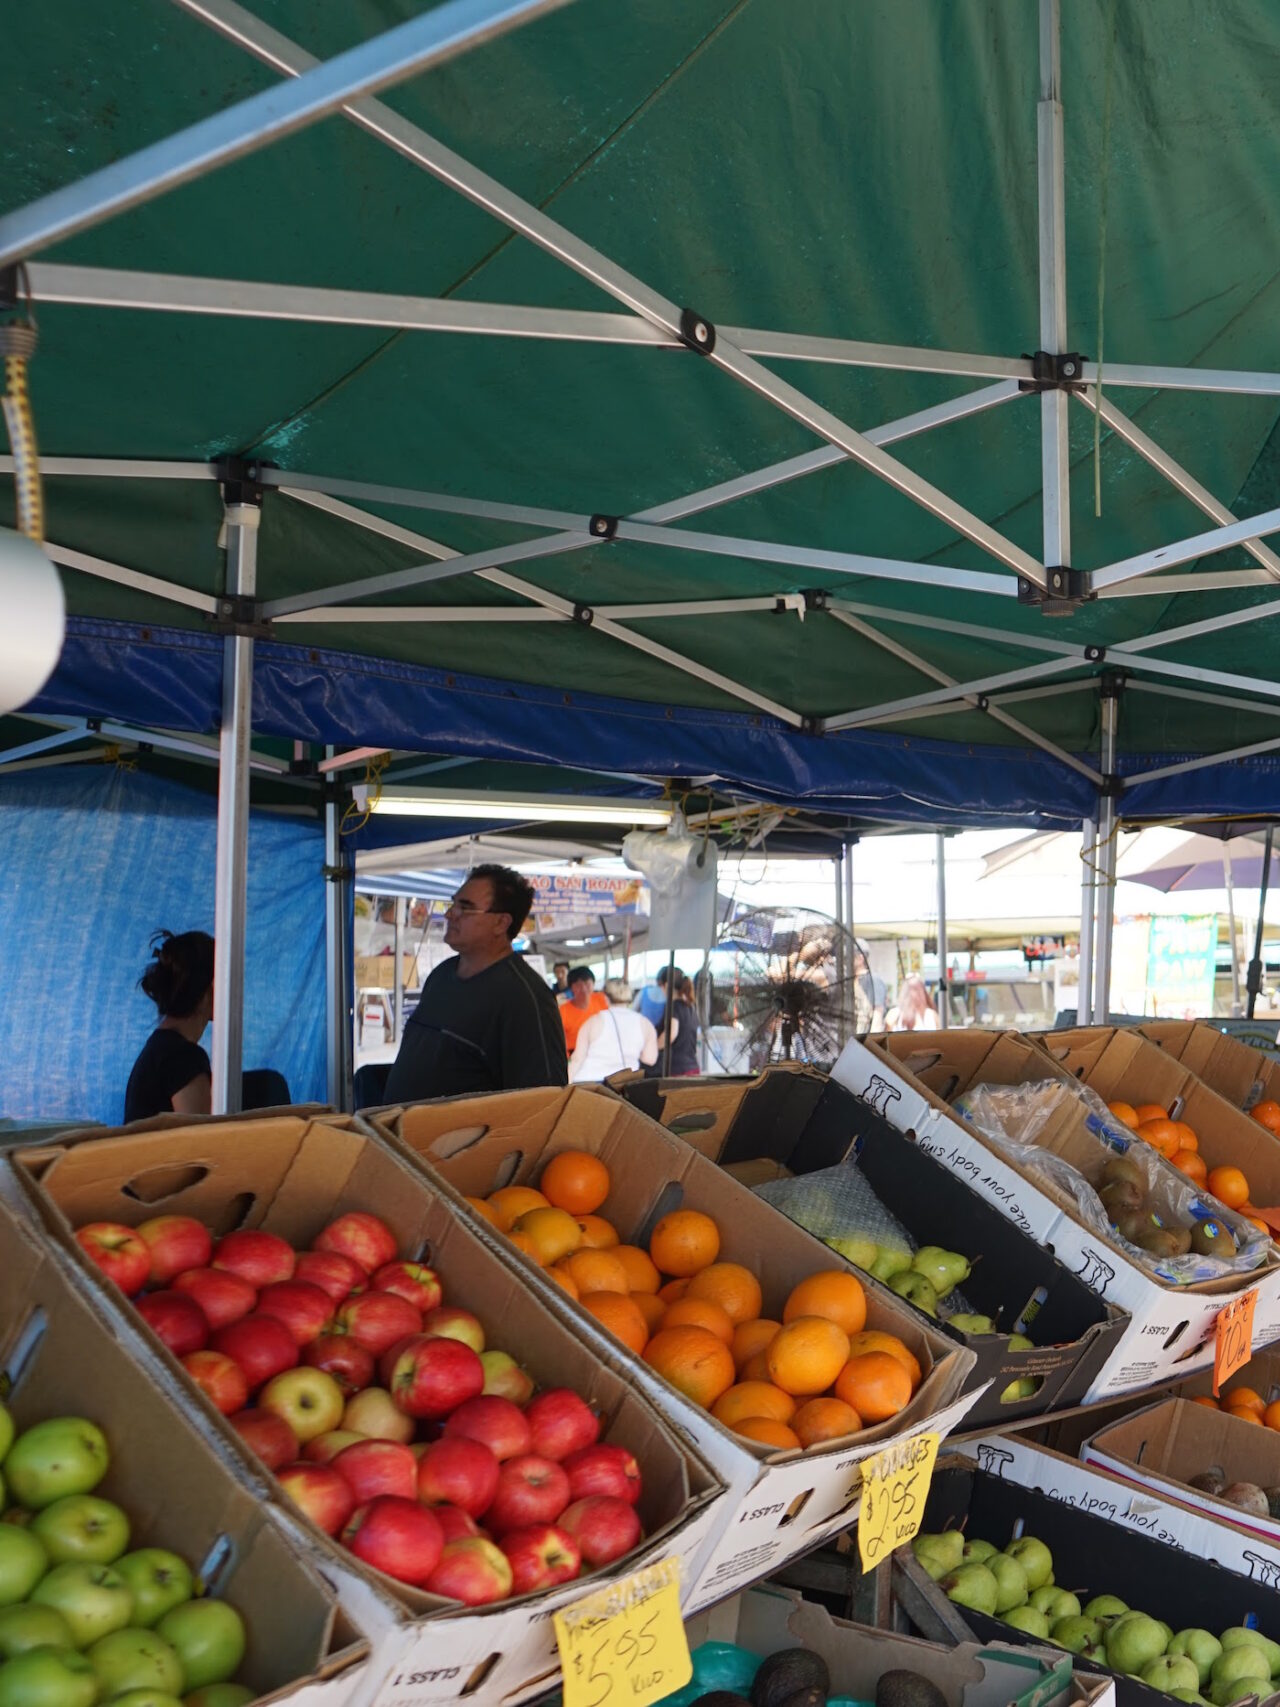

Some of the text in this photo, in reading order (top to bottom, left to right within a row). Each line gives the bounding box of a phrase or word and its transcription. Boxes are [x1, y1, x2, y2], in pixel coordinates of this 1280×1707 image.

[555, 876, 582, 890] SAN
[587, 878, 627, 891] ROAD
[947, 1148, 981, 1180] body
[980, 1176, 1015, 1204] your
[1141, 1325, 1170, 1335] CLASS 1
[738, 1502, 785, 1523] CLASS 1
[1079, 1492, 1117, 1520] body
[1119, 1511, 1158, 1533] your
[392, 1666, 460, 1686] CLASS 1
